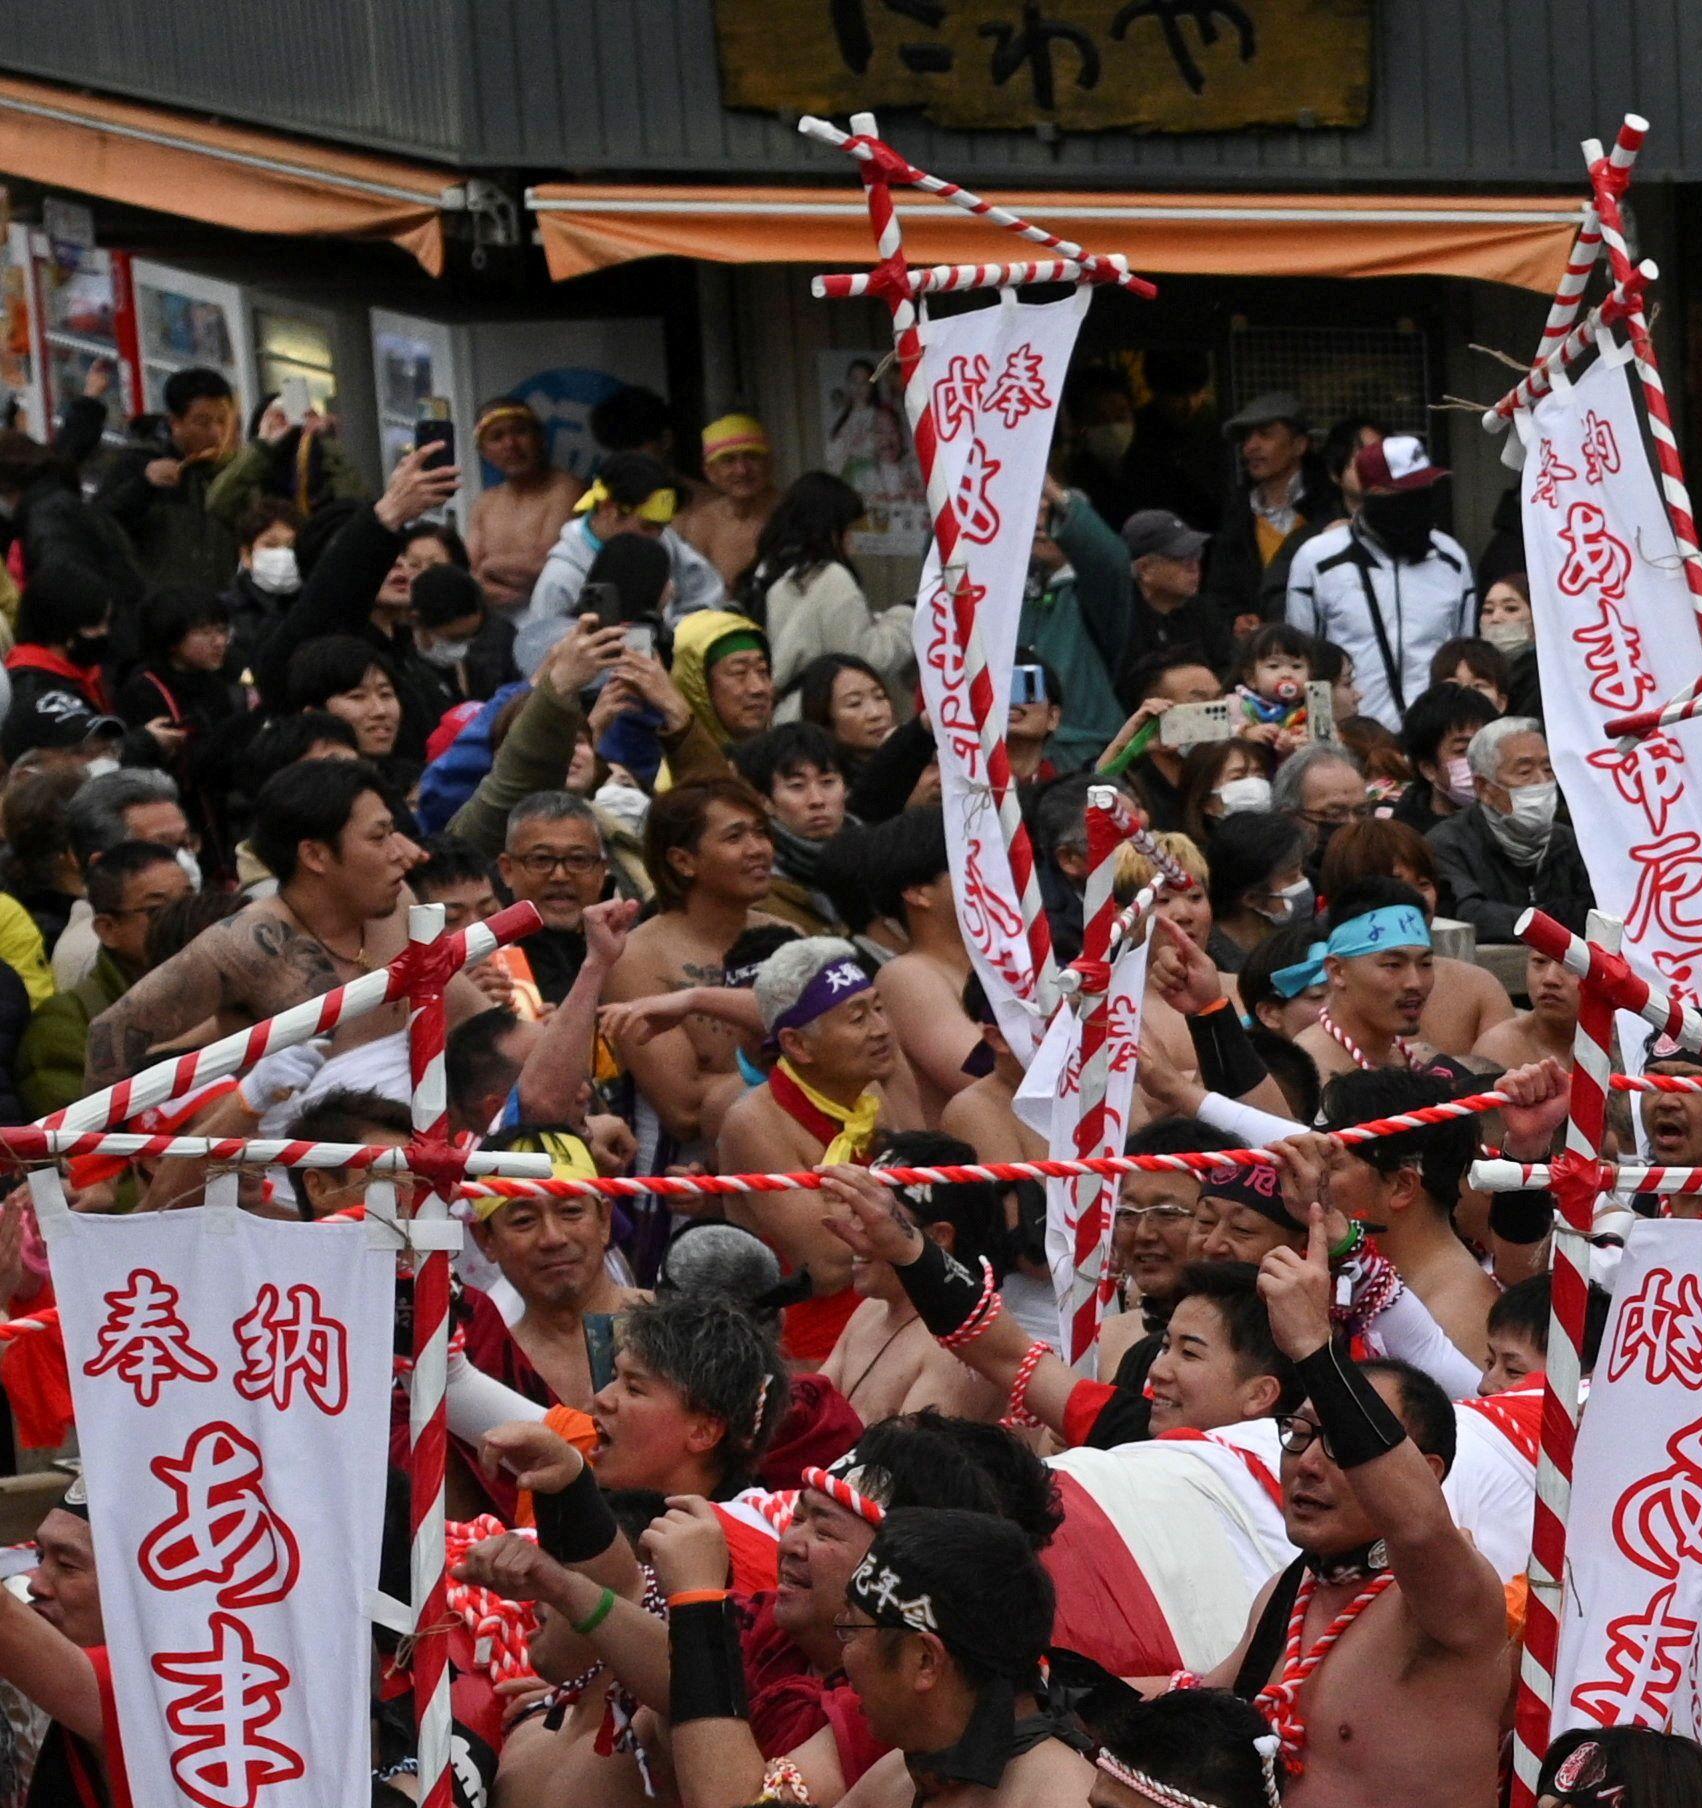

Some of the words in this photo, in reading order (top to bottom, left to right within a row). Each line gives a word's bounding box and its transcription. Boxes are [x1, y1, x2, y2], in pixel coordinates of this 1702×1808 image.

[83, 1267, 349, 1416] 奉納
[851, 1552, 939, 1632] 厄年会
